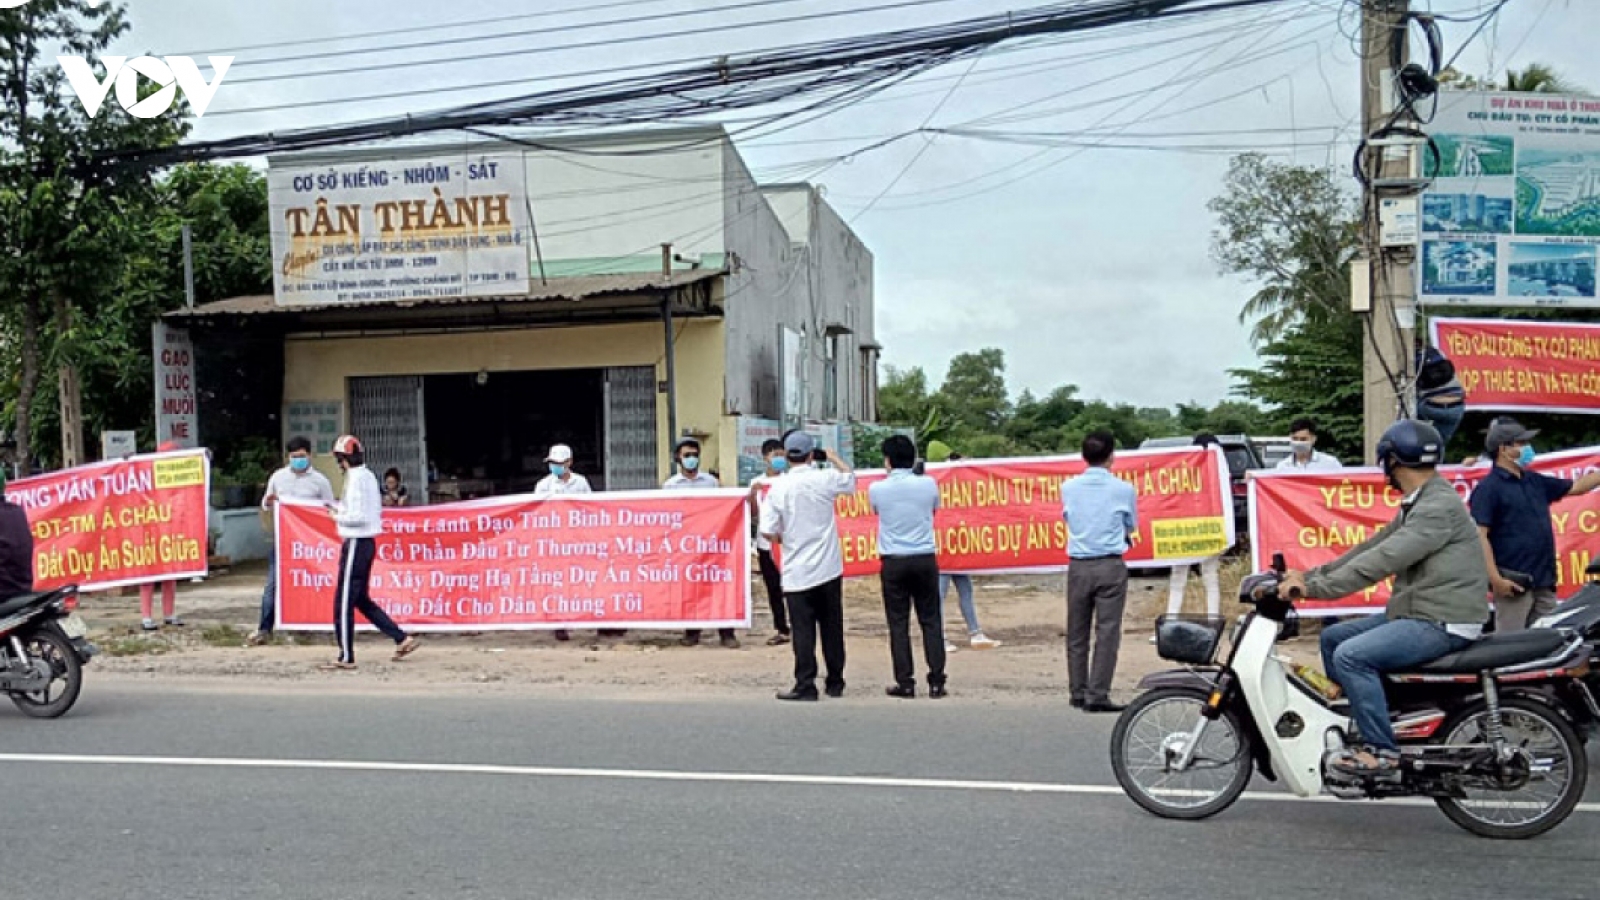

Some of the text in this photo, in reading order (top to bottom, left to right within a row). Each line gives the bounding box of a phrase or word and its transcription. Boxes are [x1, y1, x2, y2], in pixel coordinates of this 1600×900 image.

[293, 172, 313, 191] CƠ
[317, 168, 338, 189] SỞ
[343, 165, 388, 188] KIẾNG
[403, 161, 450, 183] NHÔM
[468, 156, 498, 179] SẮT
[284, 187, 511, 237] TÂN THÀNH
[940, 476, 973, 510] HẦN
[1012, 477, 1035, 505] TƯ
[1319, 478, 1375, 509] YÊU
[477, 513, 515, 535] Đạo
[617, 509, 684, 530] Dương
[945, 520, 995, 555] CÔNG
[997, 524, 1023, 558] DỰ
[1027, 515, 1049, 550] ÁN
[1298, 520, 1366, 548] GIÁM
[67, 547, 95, 581] Dự
[100, 536, 120, 572] Án
[291, 540, 335, 564] Buộc
[409, 538, 457, 561] Phần
[462, 537, 499, 560] Đầu
[505, 539, 532, 560] Tư
[536, 538, 608, 560] Thương
[615, 536, 652, 560] Mại
[659, 531, 673, 554] Á
[679, 533, 732, 555] Châu
[289, 568, 333, 592] Thực
[389, 570, 424, 593] Xây
[430, 570, 479, 592] Dựng
[485, 568, 511, 590] Hạ
[569, 565, 597, 588] Dự
[603, 561, 630, 583] Án
[637, 558, 679, 583] Suối
[686, 563, 733, 583] Giữa
[419, 593, 452, 616] Đất
[456, 597, 494, 616] Cho
[499, 595, 536, 616] Dân
[542, 593, 606, 616] Chúng
[612, 592, 644, 613] Tôi
